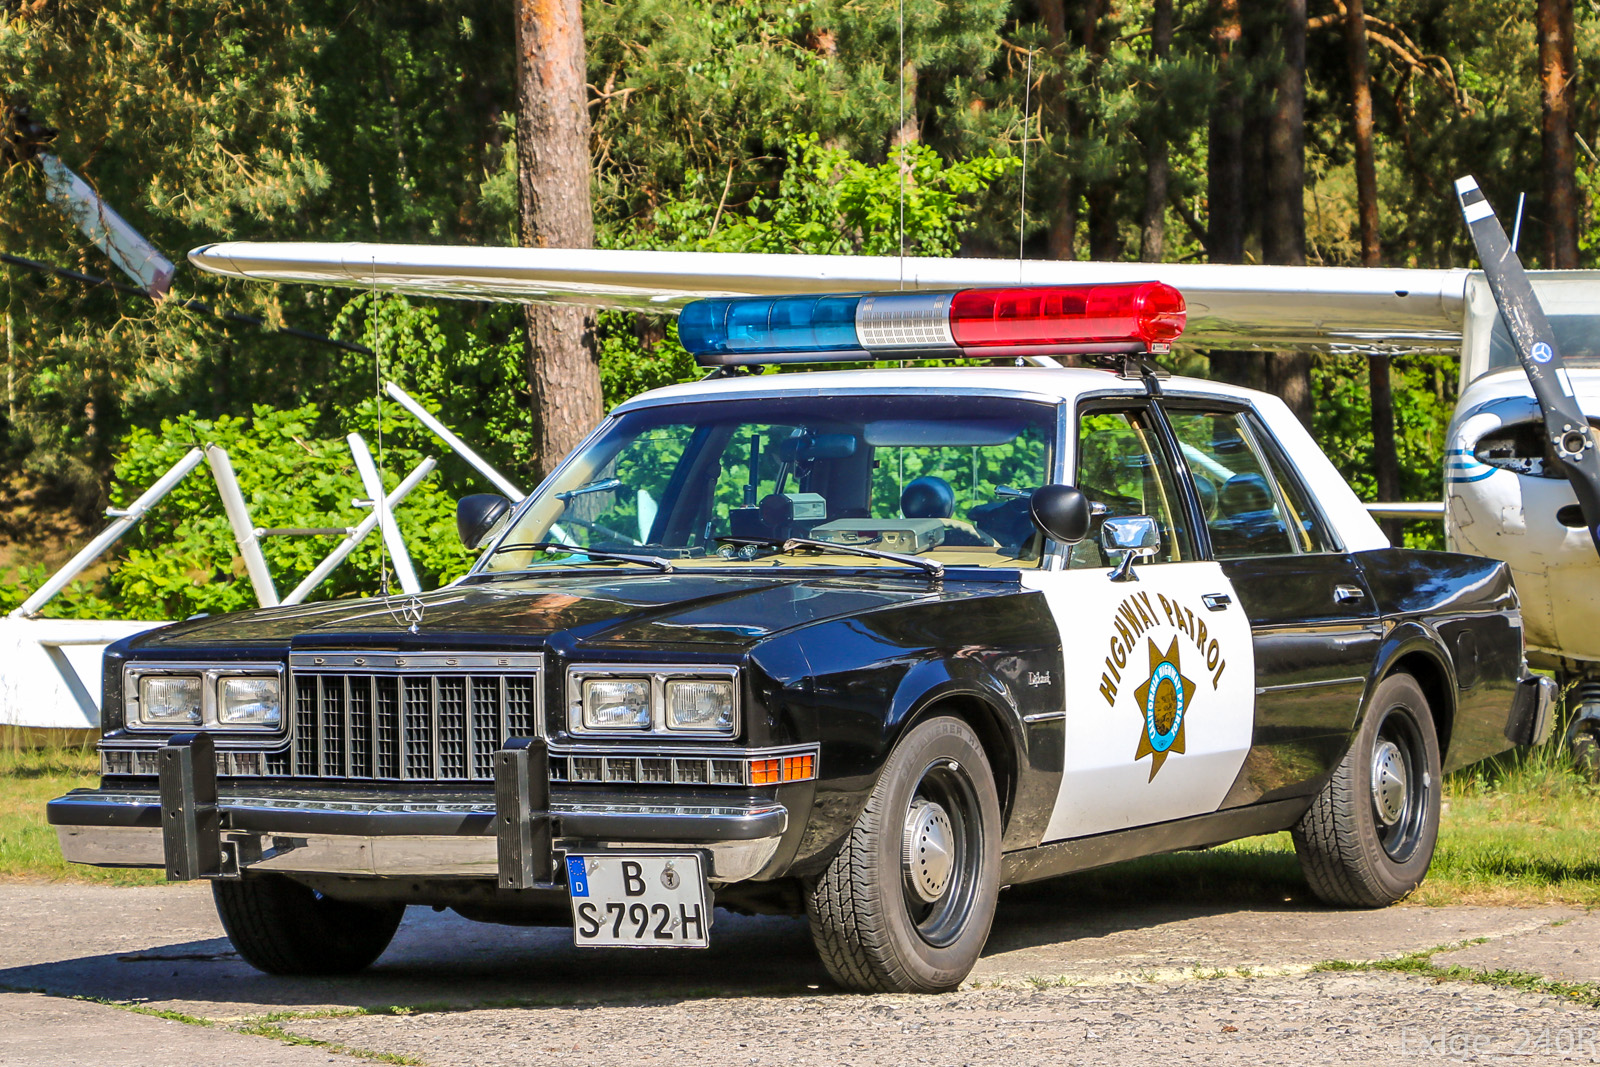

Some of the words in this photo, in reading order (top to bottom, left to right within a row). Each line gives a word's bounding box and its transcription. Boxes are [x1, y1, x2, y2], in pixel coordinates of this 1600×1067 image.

[314, 657, 509, 666] DODGE
[1099, 591, 1161, 707] HIGHWAY
[1157, 593, 1226, 691] PATROL
[1147, 674, 1159, 739] CALIFORNIA
[1170, 693, 1183, 736] PATROL
[575, 882, 584, 892] D
[621, 861, 647, 897] B
